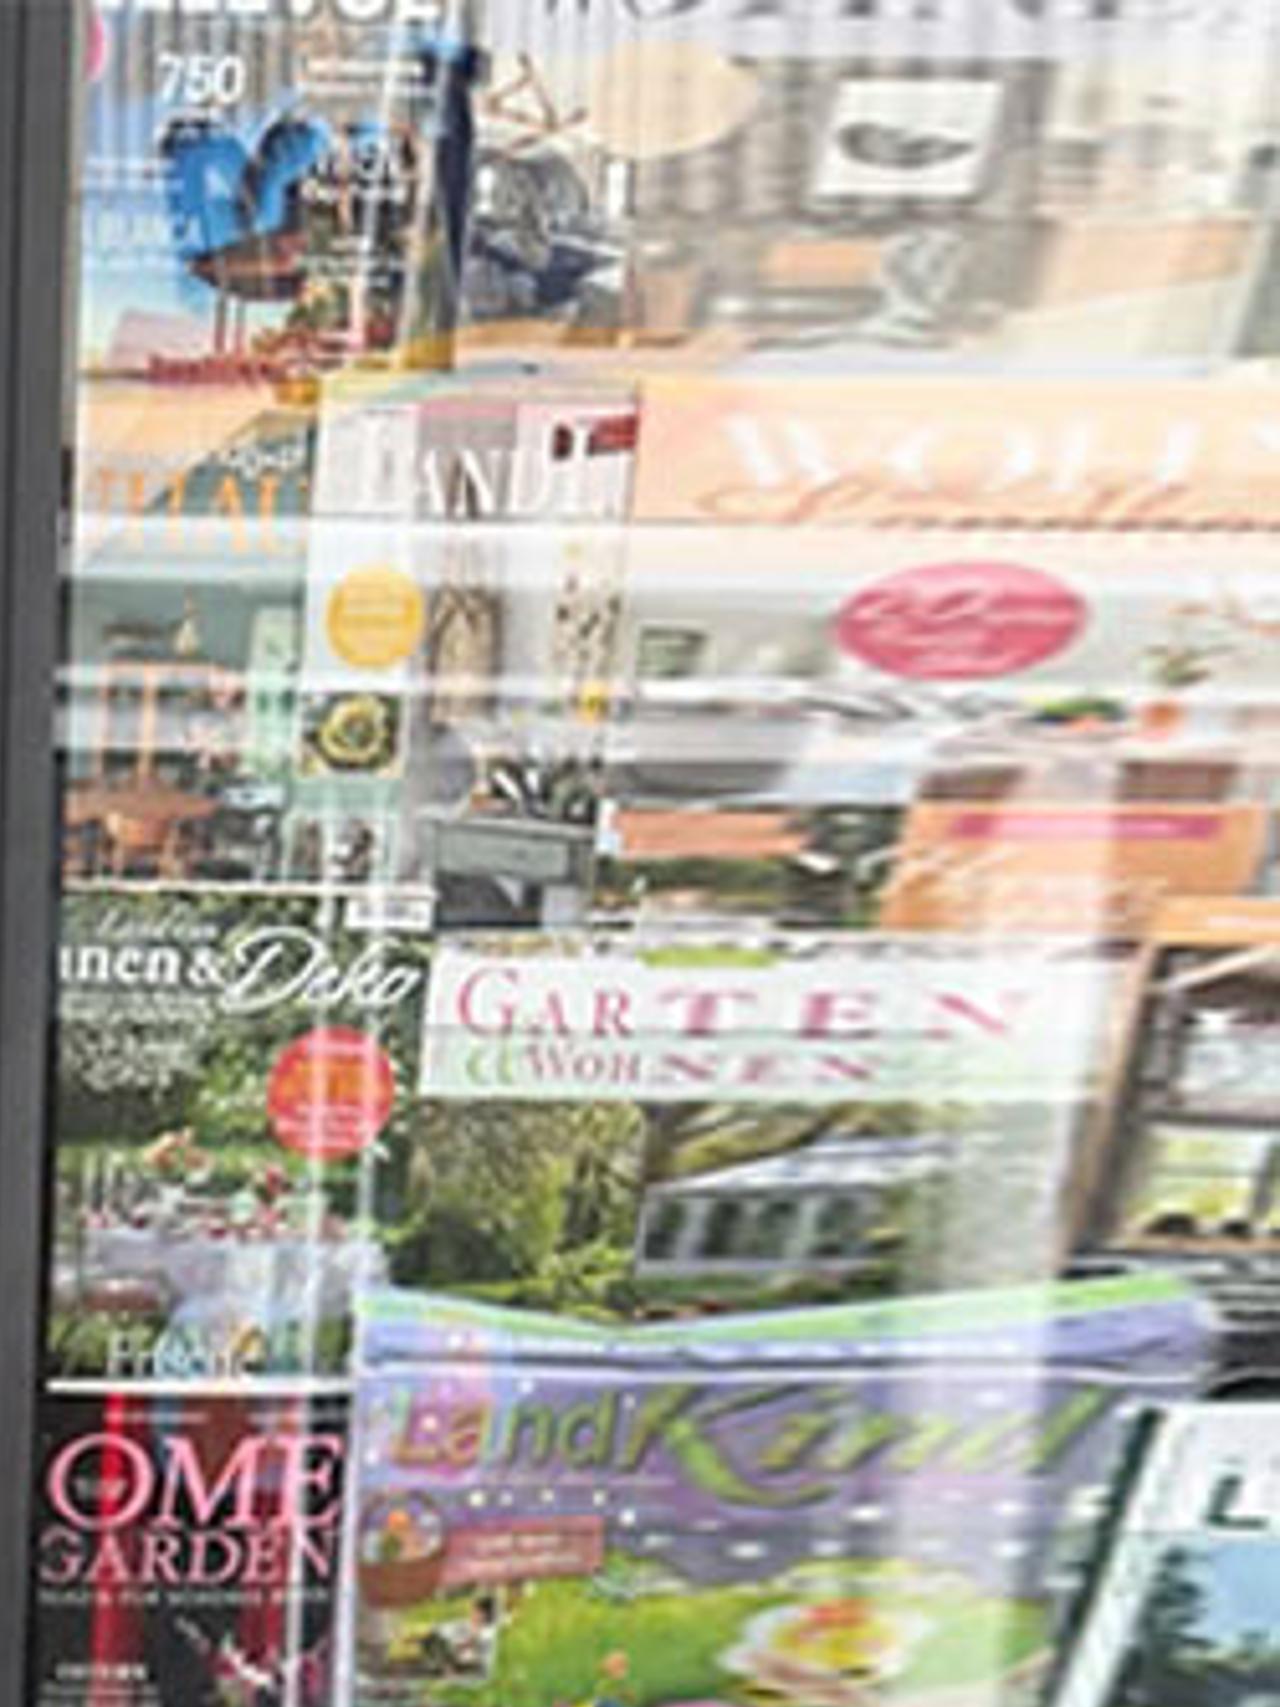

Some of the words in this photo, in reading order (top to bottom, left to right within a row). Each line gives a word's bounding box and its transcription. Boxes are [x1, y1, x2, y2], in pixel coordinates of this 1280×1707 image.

[158, 53, 244, 102] 750
[222, 925, 422, 1016] Deko
[454, 963, 1022, 1040] GARTEN
[46, 1432, 342, 1530] OME
[38, 1526, 334, 1586] GARDEN
